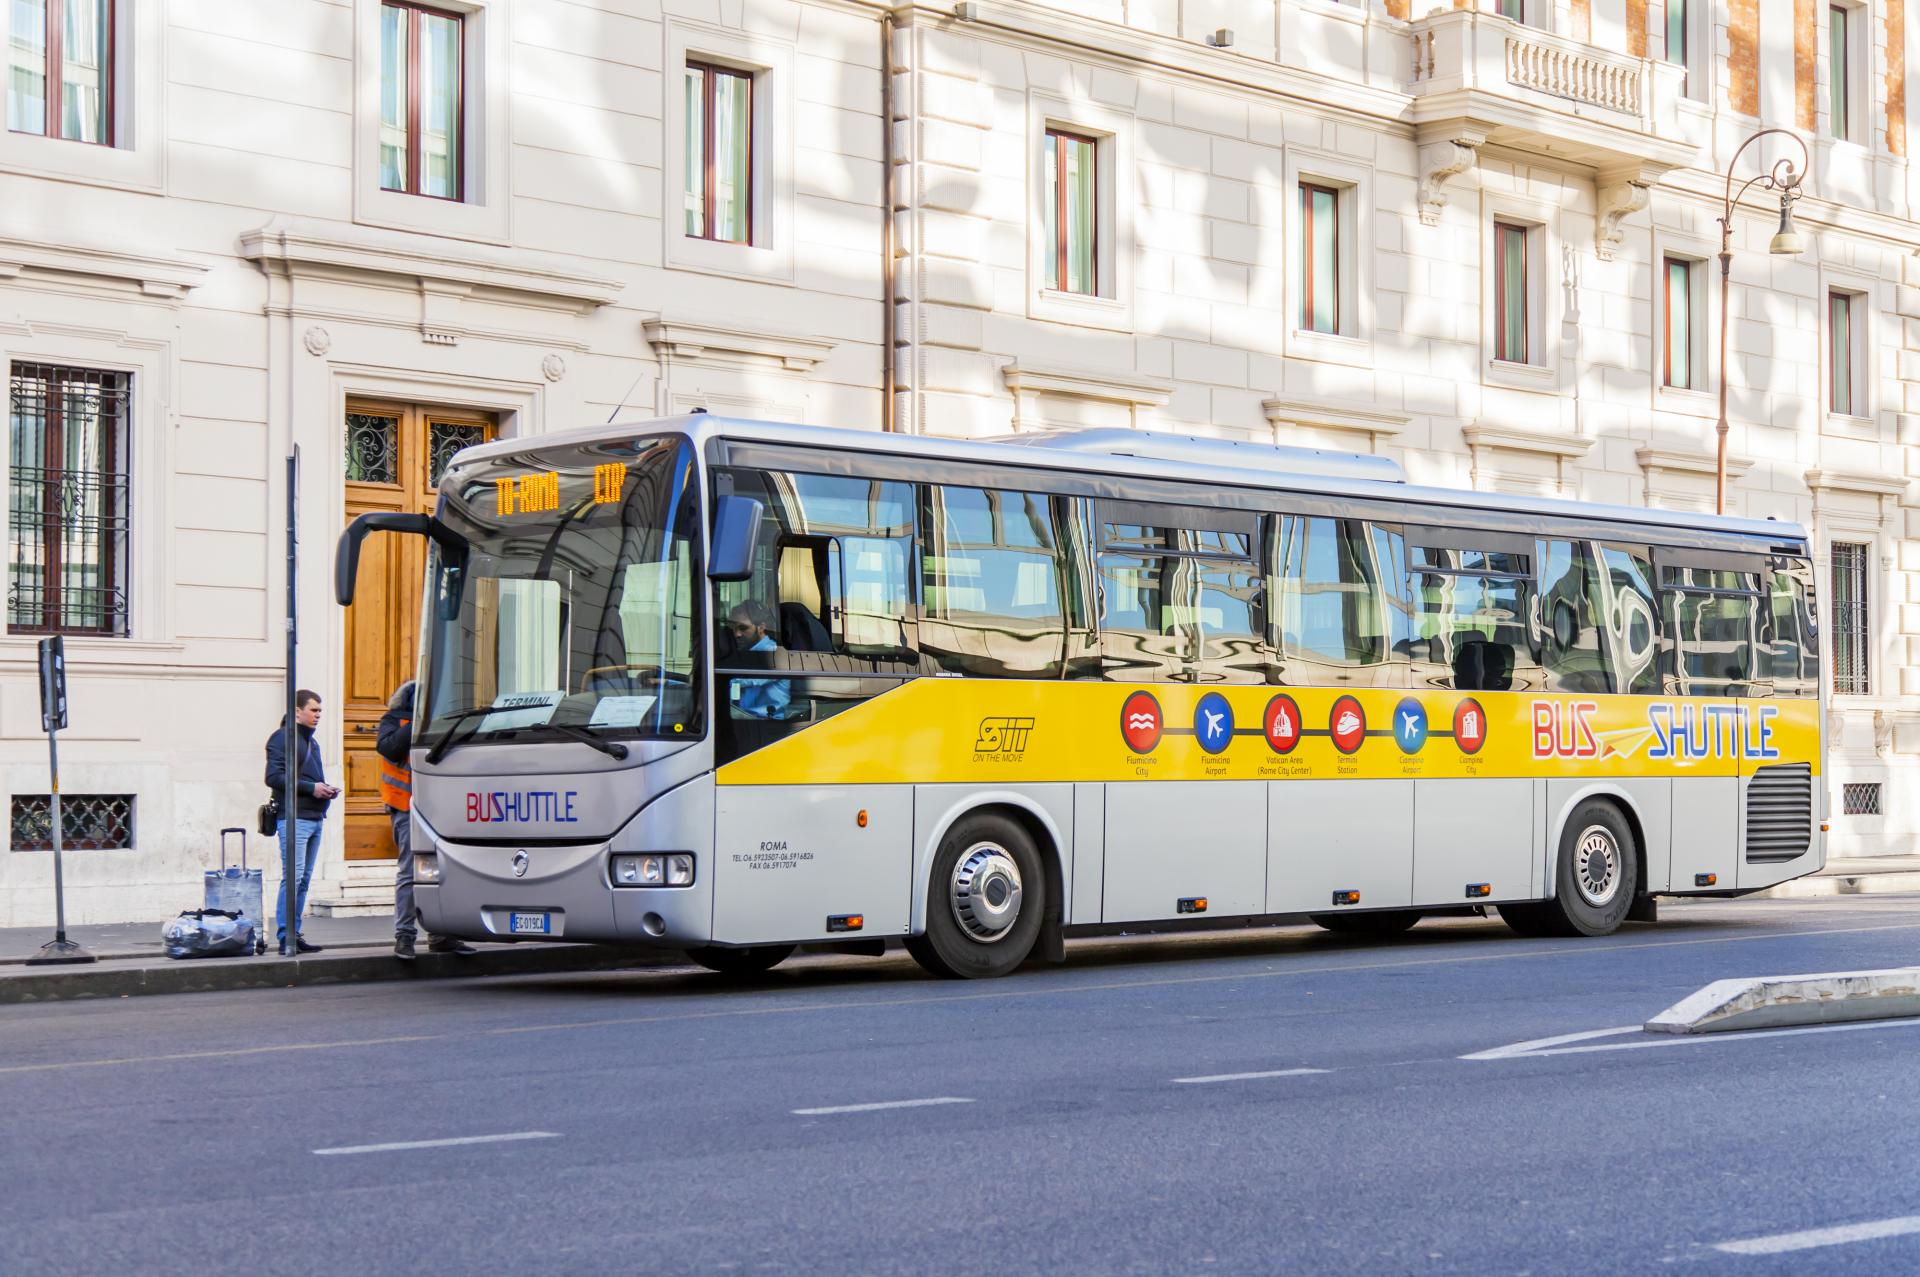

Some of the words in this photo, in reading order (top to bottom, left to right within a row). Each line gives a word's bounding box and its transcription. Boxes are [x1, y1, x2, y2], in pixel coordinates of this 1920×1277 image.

[975, 717, 1035, 752] SIT
[1532, 701, 1599, 759] BUS
[1647, 704, 1780, 759] SHUTTLE
[973, 754, 984, 762] ON
[986, 753, 1001, 762] THE
[1002, 753, 1024, 762] MOVE
[1126, 756, 1157, 765] Fiumicino
[1201, 756, 1230, 765] Fiumicino
[1266, 756, 1287, 765] Vatican
[1290, 756, 1303, 764] Area
[1337, 756, 1357, 764] Termini
[1400, 756, 1424, 766] Ciampino
[1459, 756, 1483, 765] Ciampino
[1135, 767, 1149, 777] City
[1205, 767, 1227, 776] Airport
[1257, 766, 1276, 775] (Rome
[1277, 766, 1289, 777] City
[1290, 766, 1312, 776] Center)
[1337, 766, 1357, 774] Station
[1402, 766, 1421, 775] Airport
[1466, 766, 1477, 775] City
[467, 791, 578, 822] BUSHUTTLE
[760, 841, 787, 851] ROMA
